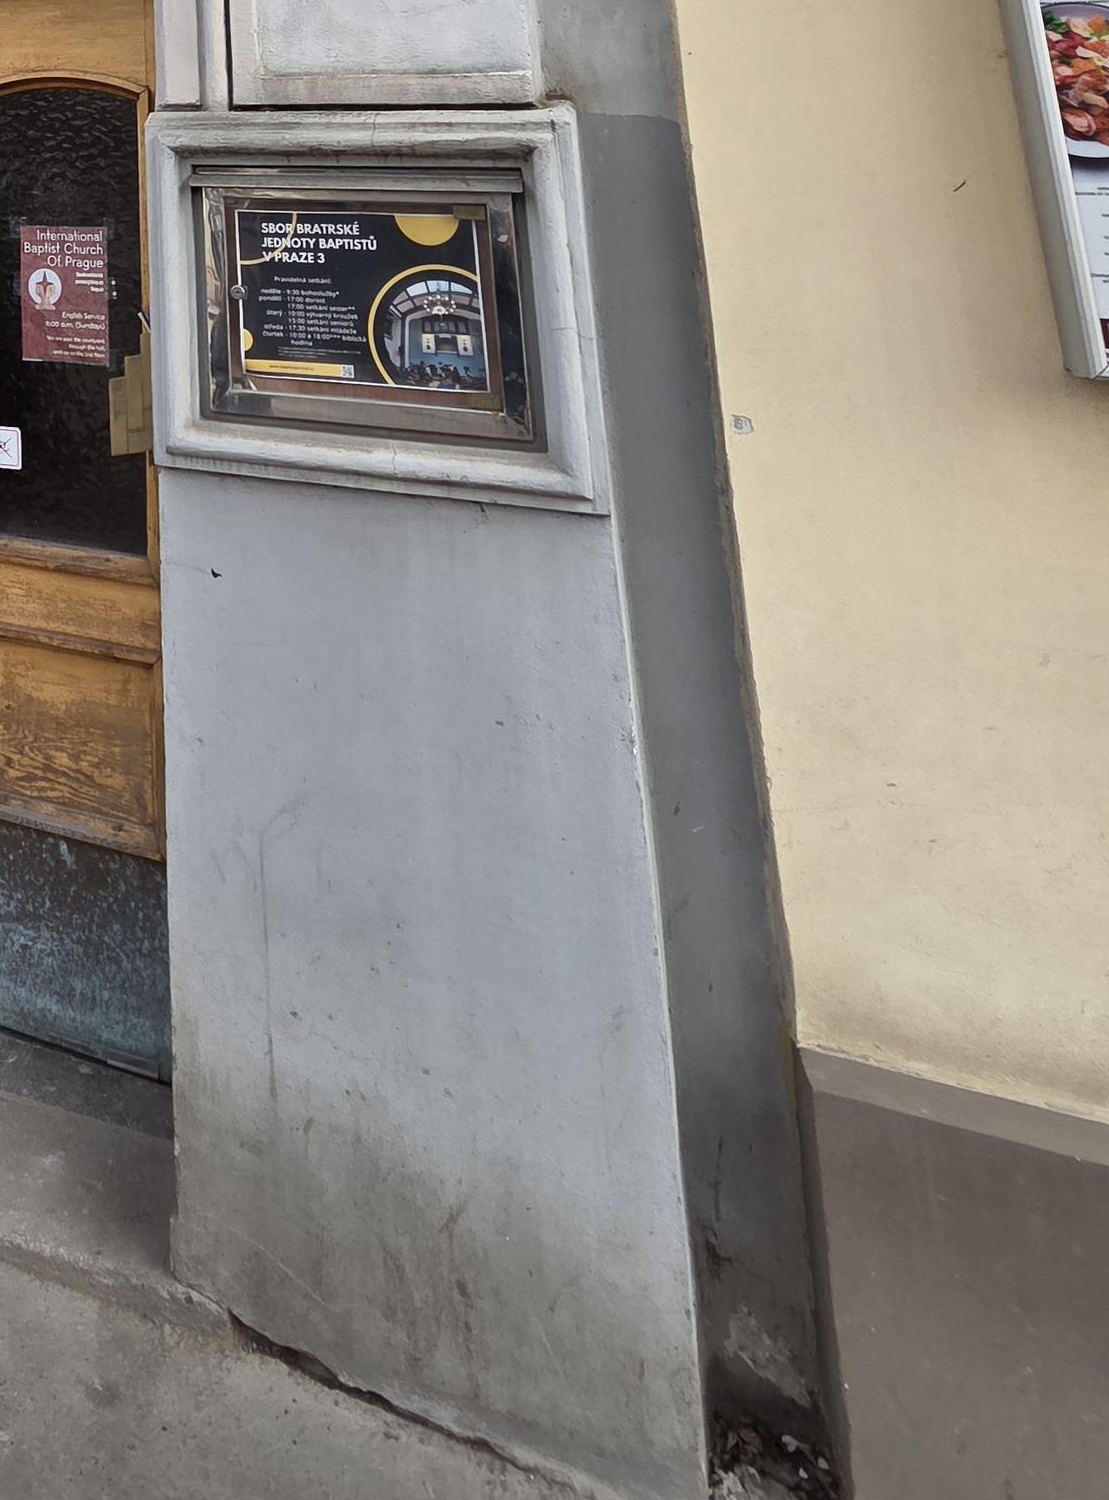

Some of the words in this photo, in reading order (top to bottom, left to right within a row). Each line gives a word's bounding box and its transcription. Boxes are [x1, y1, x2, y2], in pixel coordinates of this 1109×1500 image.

[37, 229, 102, 241] International
[261, 222, 294, 234] SBOR
[296, 221, 360, 235] BRATRSKÉ
[24, 242, 60, 256] Baptist
[64, 243, 103, 254] Church
[261, 237, 316, 249] JEDNOTY
[319, 235, 377, 250] BAPTISTŮ
[47, 255, 62, 267] Of
[65, 256, 103, 270] Prague
[275, 251, 315, 263] PRAZE
[317, 252, 325, 263] 3
